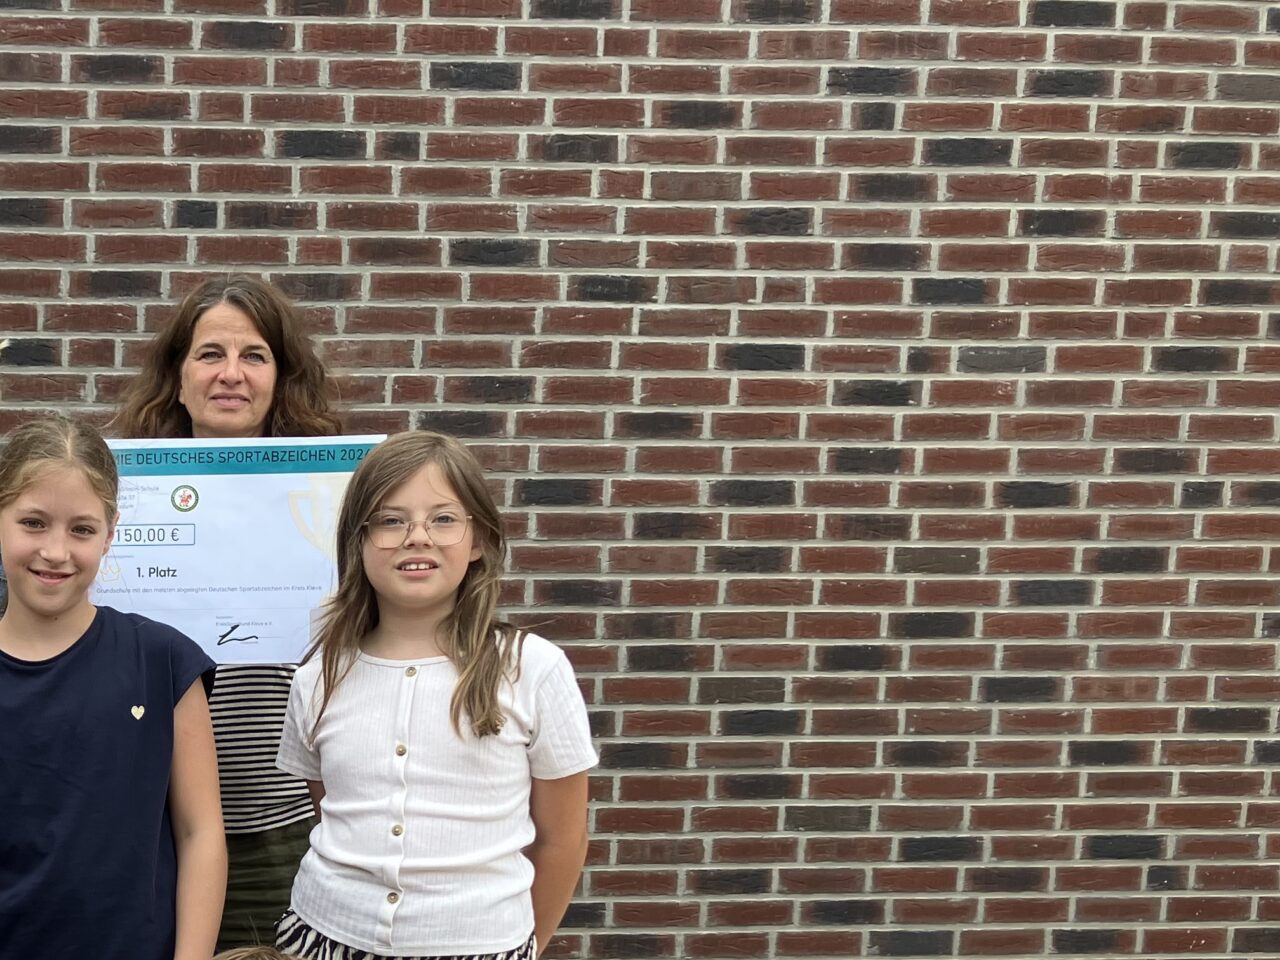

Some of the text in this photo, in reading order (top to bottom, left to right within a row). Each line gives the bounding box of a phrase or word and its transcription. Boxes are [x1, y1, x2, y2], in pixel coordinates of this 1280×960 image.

[136, 452, 215, 465] DEUTSCHES
[218, 449, 336, 464] SPORTABZEICHEN
[116, 527, 180, 543] 150,00 €
[136, 566, 178, 578] 1. Platz
